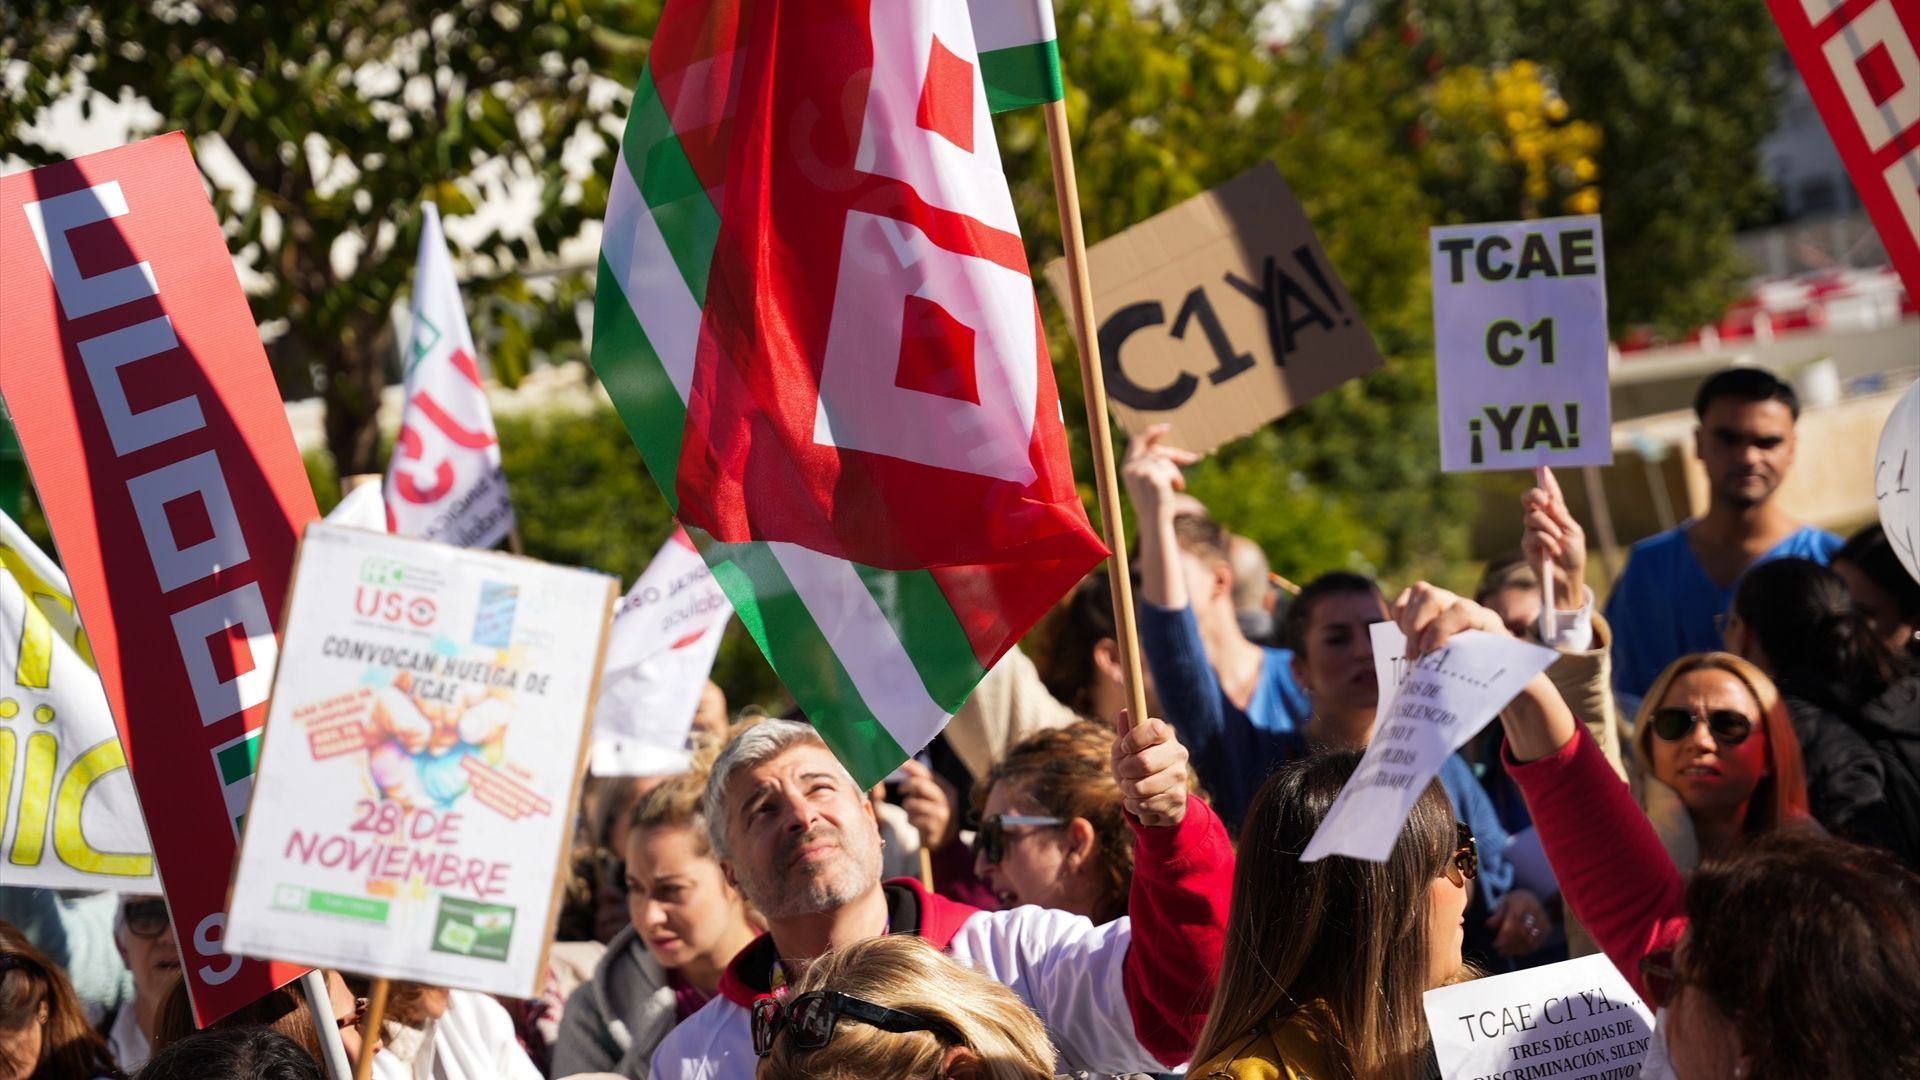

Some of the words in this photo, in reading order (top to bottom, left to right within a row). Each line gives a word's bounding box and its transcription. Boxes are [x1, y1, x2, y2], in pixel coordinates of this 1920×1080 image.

[1438, 229, 1597, 283] TCAE
[1098, 285, 1256, 411] C1
[1223, 245, 1352, 367] YA!
[1486, 317, 1555, 367] C1
[1469, 403, 1580, 464] ¡YA!
[354, 585, 437, 628] USO
[322, 636, 435, 674] CONVOCAN
[441, 653, 519, 690] HUELGA
[524, 672, 552, 696] DE
[407, 674, 459, 704] TCAE
[349, 800, 401, 835] 28
[410, 808, 464, 845] DE
[283, 829, 512, 898] NOVIEMBRE
[1458, 1003, 1537, 1042] TCAE
[1543, 995, 1577, 1025] C1
[1509, 1038, 1550, 1061] TRES
[1555, 1023, 1616, 1051] DÉCADAS
[1616, 1019, 1635, 1036] DE
[1610, 1036, 1650, 1060] SILENC
